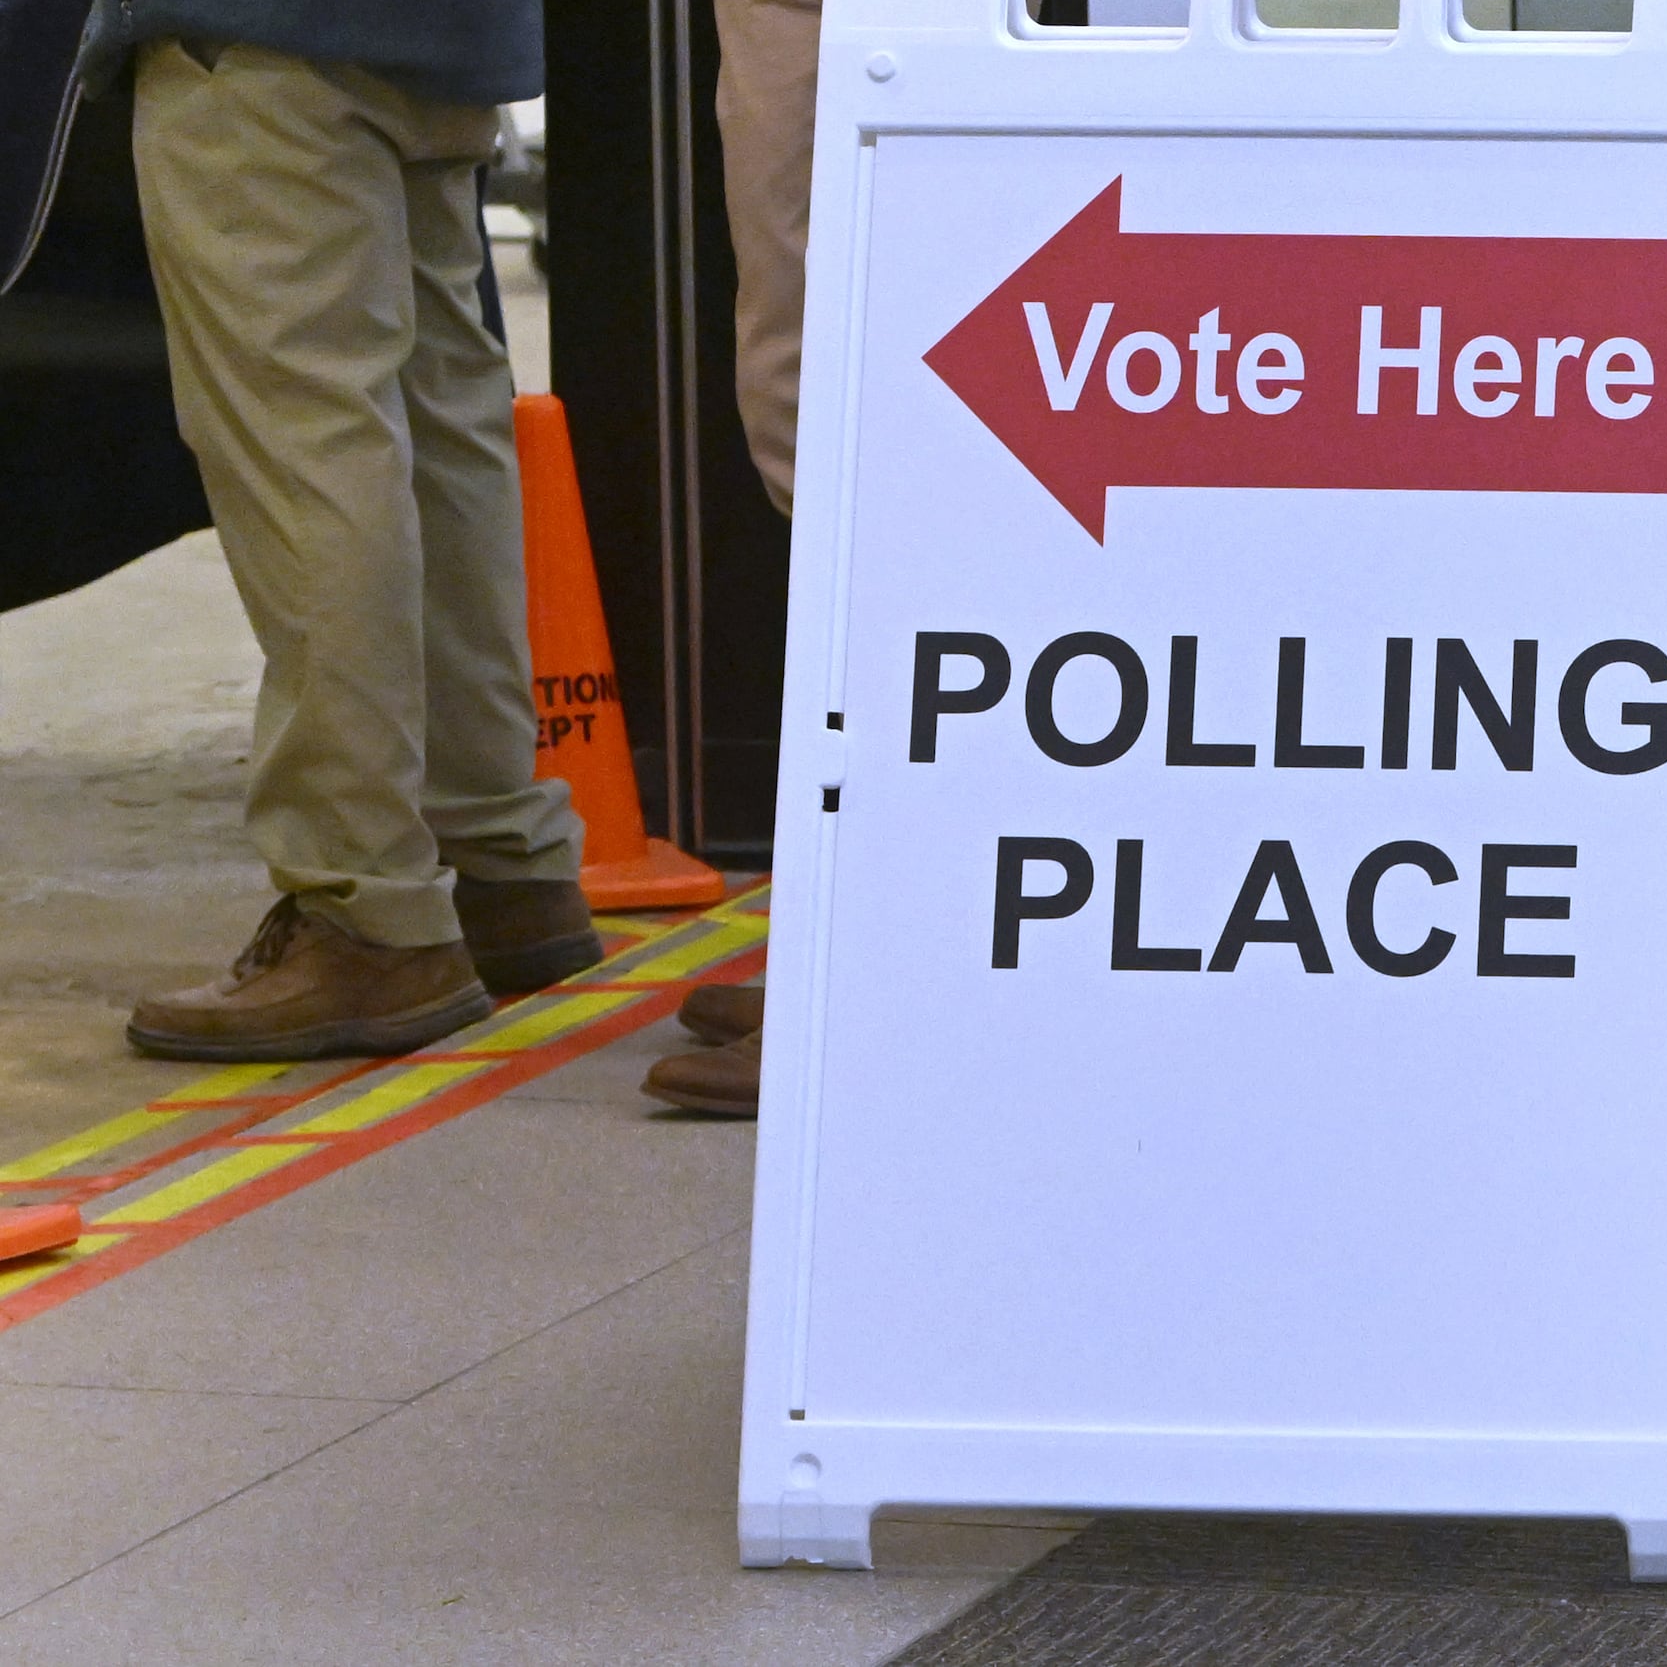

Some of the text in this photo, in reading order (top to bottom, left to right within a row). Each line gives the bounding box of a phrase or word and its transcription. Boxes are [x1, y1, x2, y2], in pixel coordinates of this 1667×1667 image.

[1023, 301, 1655, 420] Vote Here
[535, 673, 619, 707] TION
[536, 714, 595, 749] EPT
[991, 836, 1578, 978] PLACE
